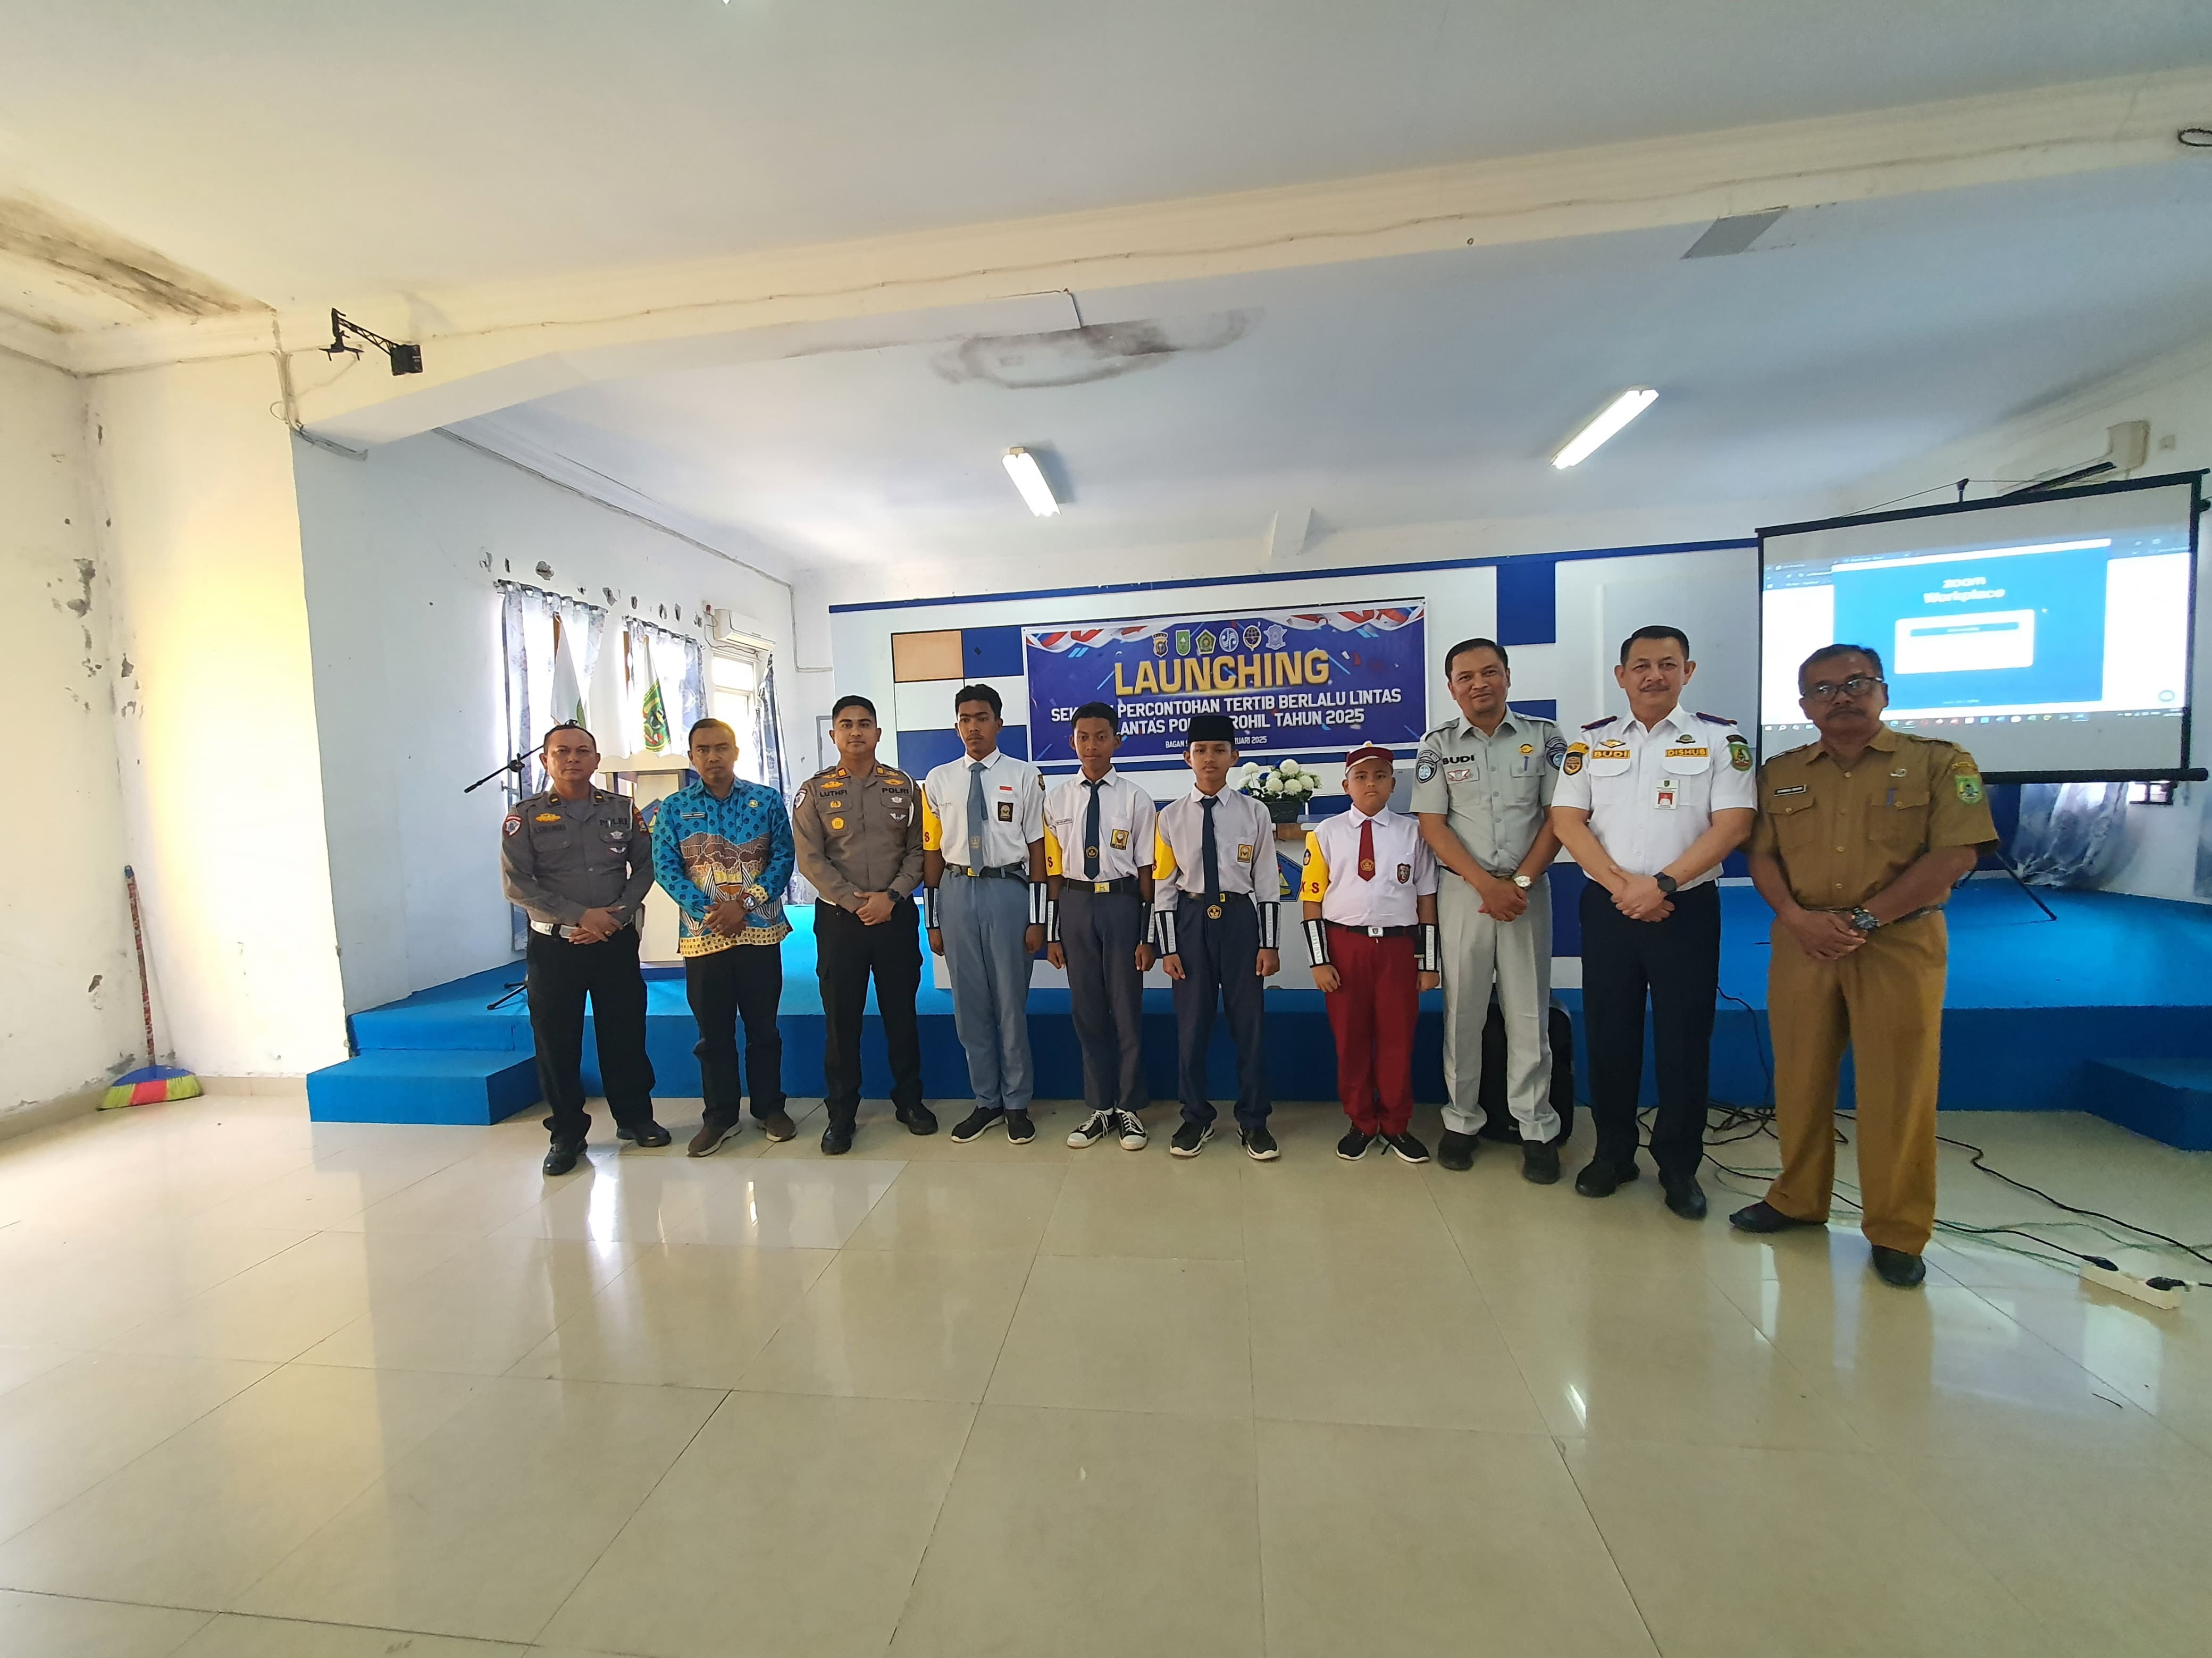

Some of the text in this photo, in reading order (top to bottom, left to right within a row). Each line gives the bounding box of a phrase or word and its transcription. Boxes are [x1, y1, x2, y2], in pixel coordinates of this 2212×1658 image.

[1115, 650, 1329, 696] LAUNCHING
[1117, 698, 1220, 718] PERCONTOHAN
[1224, 695, 1275, 712] TERTIB
[1278, 691, 1346, 709] BERLALU
[1350, 688, 1402, 705] LINTAS
[1116, 719, 1166, 736] ANTAS
[1229, 714, 1271, 729] ROHIL
[1274, 711, 1322, 727] TAHUN
[1325, 708, 1364, 725] 2025
[1165, 740, 1185, 748] BAGAN
[1234, 736, 1250, 745] UARI
[1251, 735, 1268, 744] 2025
[1594, 750, 1628, 759] BUDI
[1667, 748, 1706, 756] DISHUB
[1442, 754, 1475, 765] BUDI
[599, 818, 627, 827] POLRI
[1048, 856, 1053, 868] S
